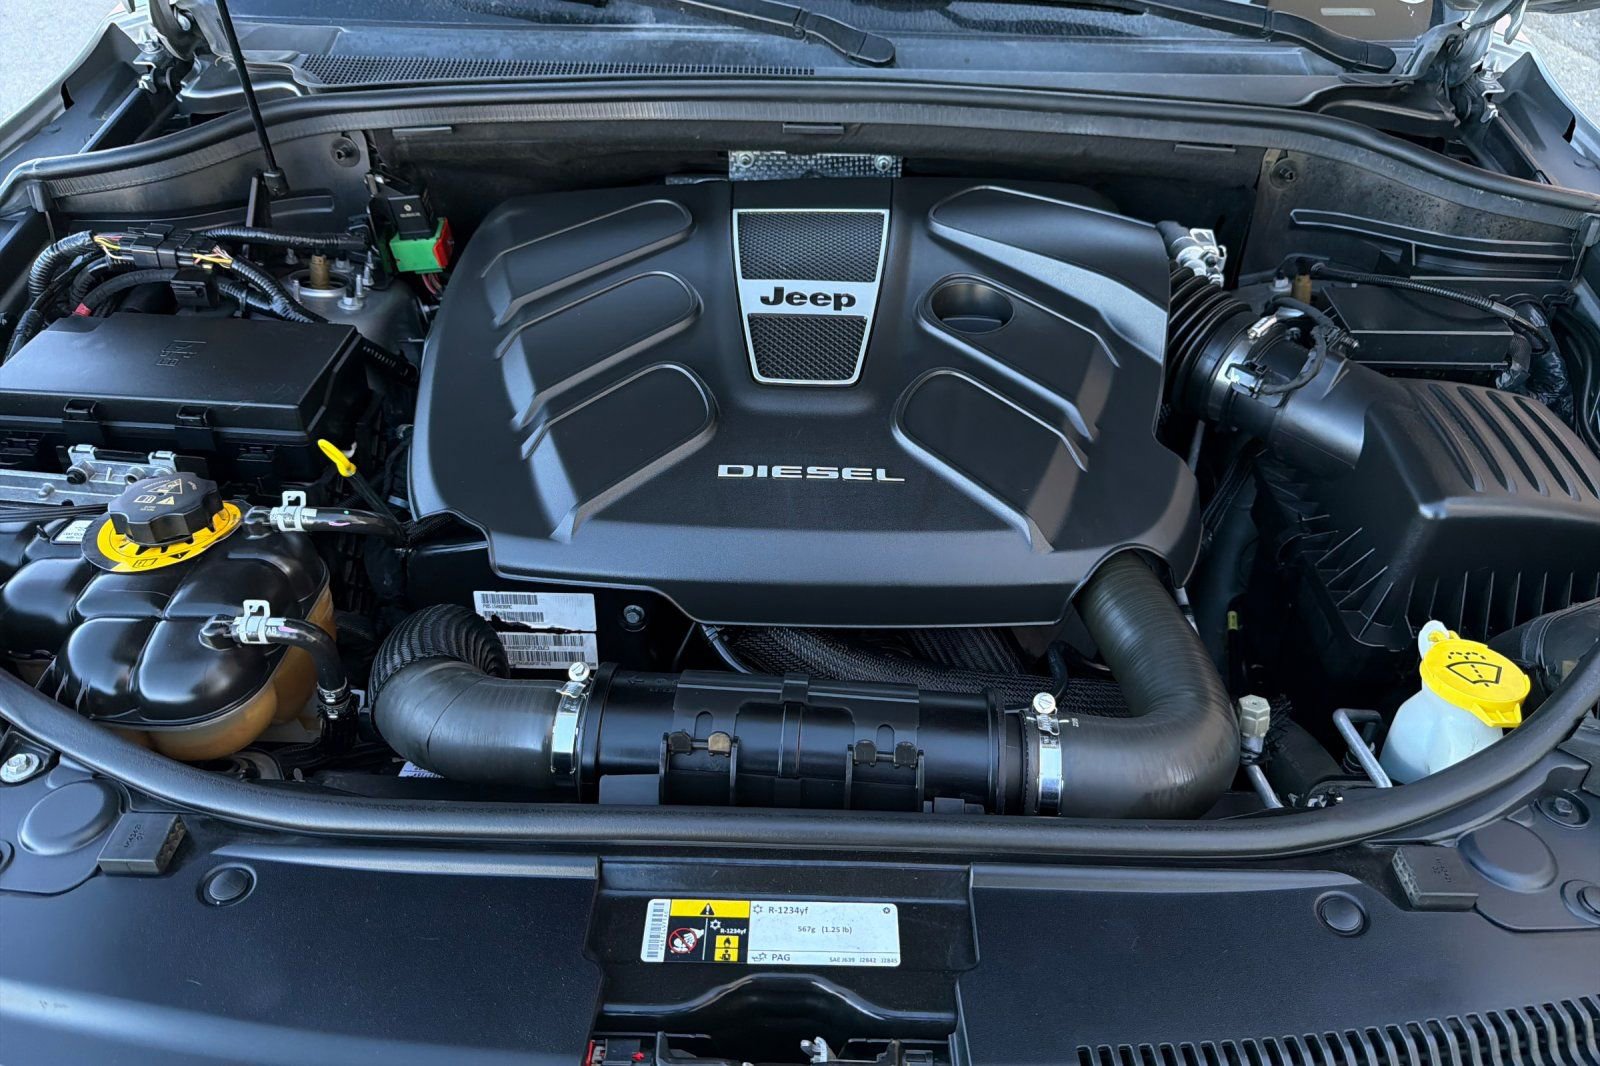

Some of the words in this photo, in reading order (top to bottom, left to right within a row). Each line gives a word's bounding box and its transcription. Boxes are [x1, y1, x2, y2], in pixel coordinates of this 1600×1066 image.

[760, 286, 856, 311] Jeep
[717, 464, 906, 482] DIESEL
[768, 906, 809, 916] R-1234yf
[797, 926, 816, 934] 567g
[821, 926, 841, 934] (1.25
[842, 926, 853, 935] lb)
[771, 954, 791, 962] PAG
